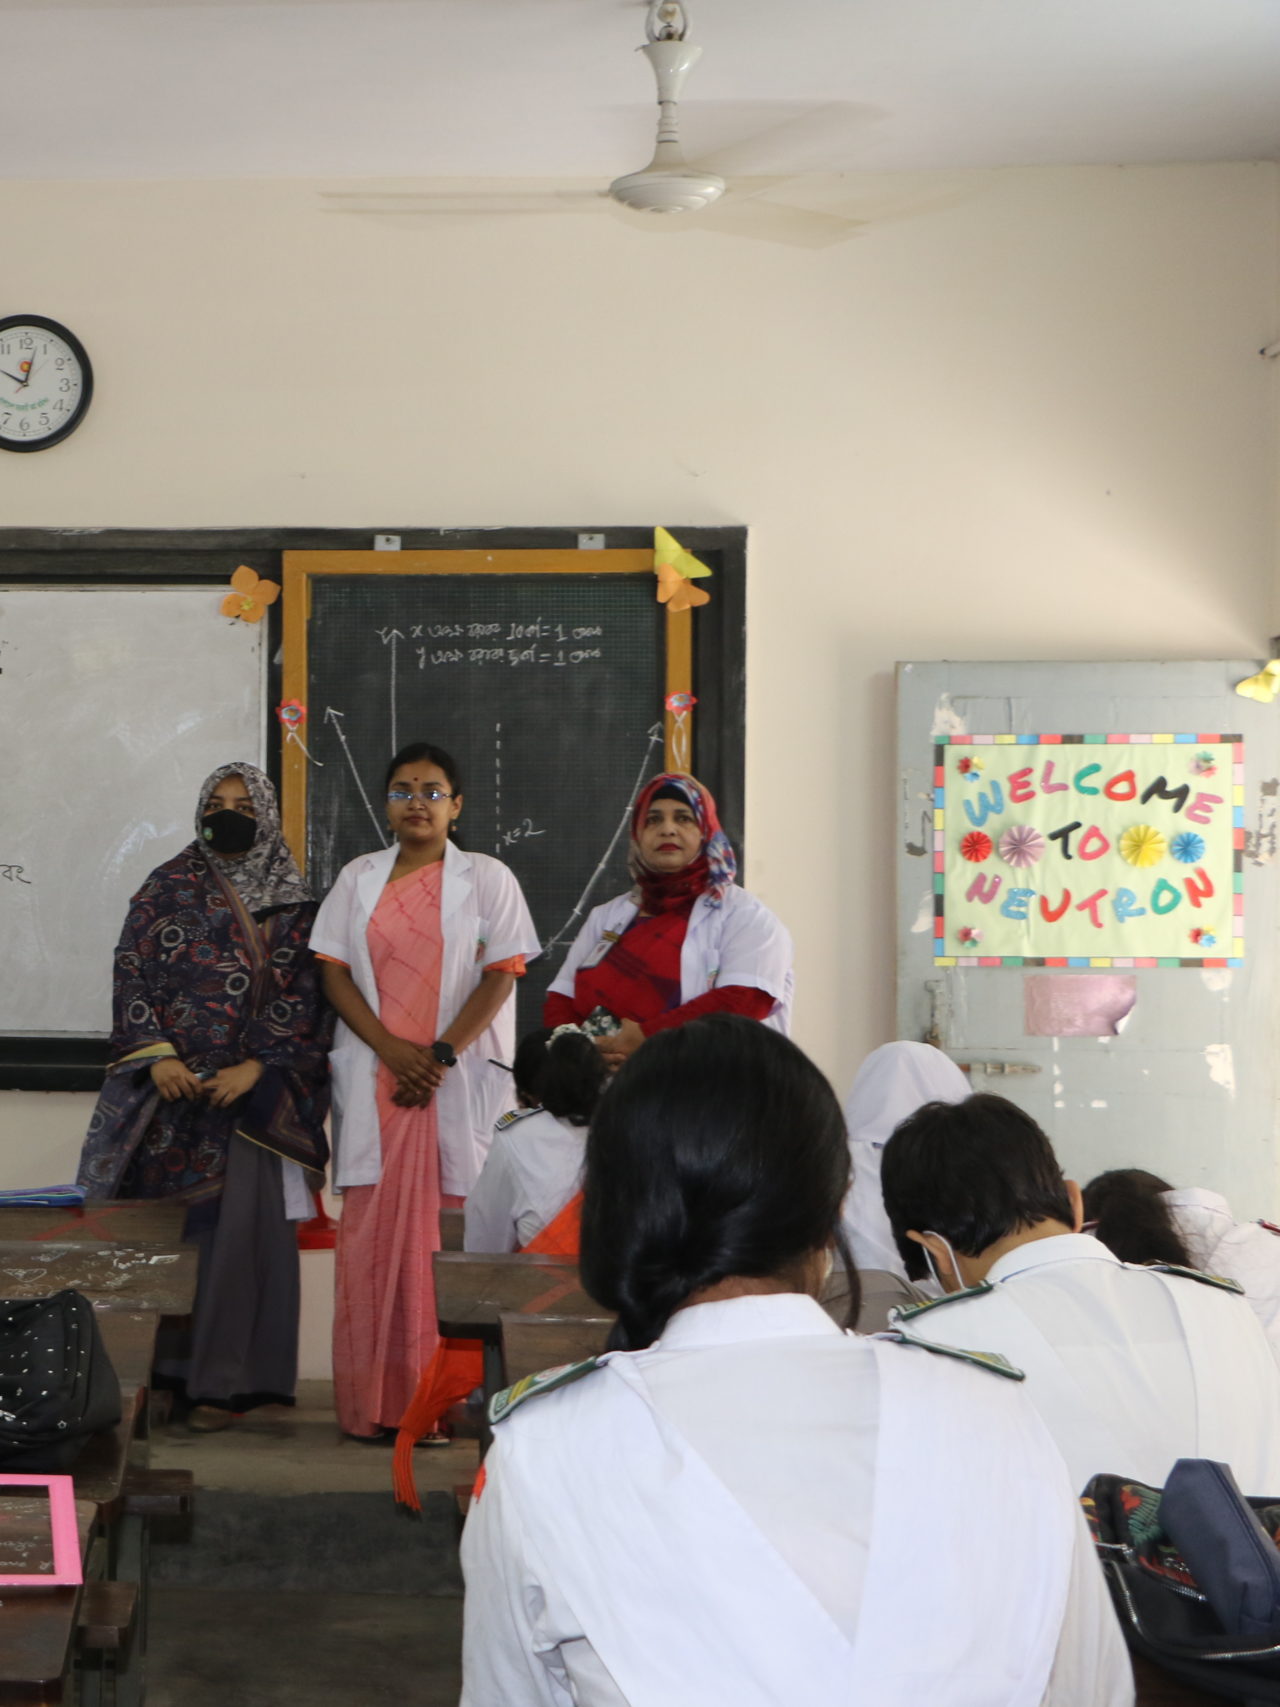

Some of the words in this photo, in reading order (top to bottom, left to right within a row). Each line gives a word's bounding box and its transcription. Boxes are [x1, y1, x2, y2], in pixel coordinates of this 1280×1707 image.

[1, 344, 11, 355] 11
[19, 337, 33, 350] 12
[43, 344, 47, 355] 1
[55, 358, 65, 370] 2
[59, 378, 70, 392] 3
[53, 399, 64, 411] 4
[2, 412, 12, 425] 7
[19, 417, 30, 431] 6
[39, 412, 50, 426] 5
[963, 759, 1224, 827] WELCOME
[1048, 820, 1111, 861] TO
[965, 867, 1214, 929] NEUTRON
